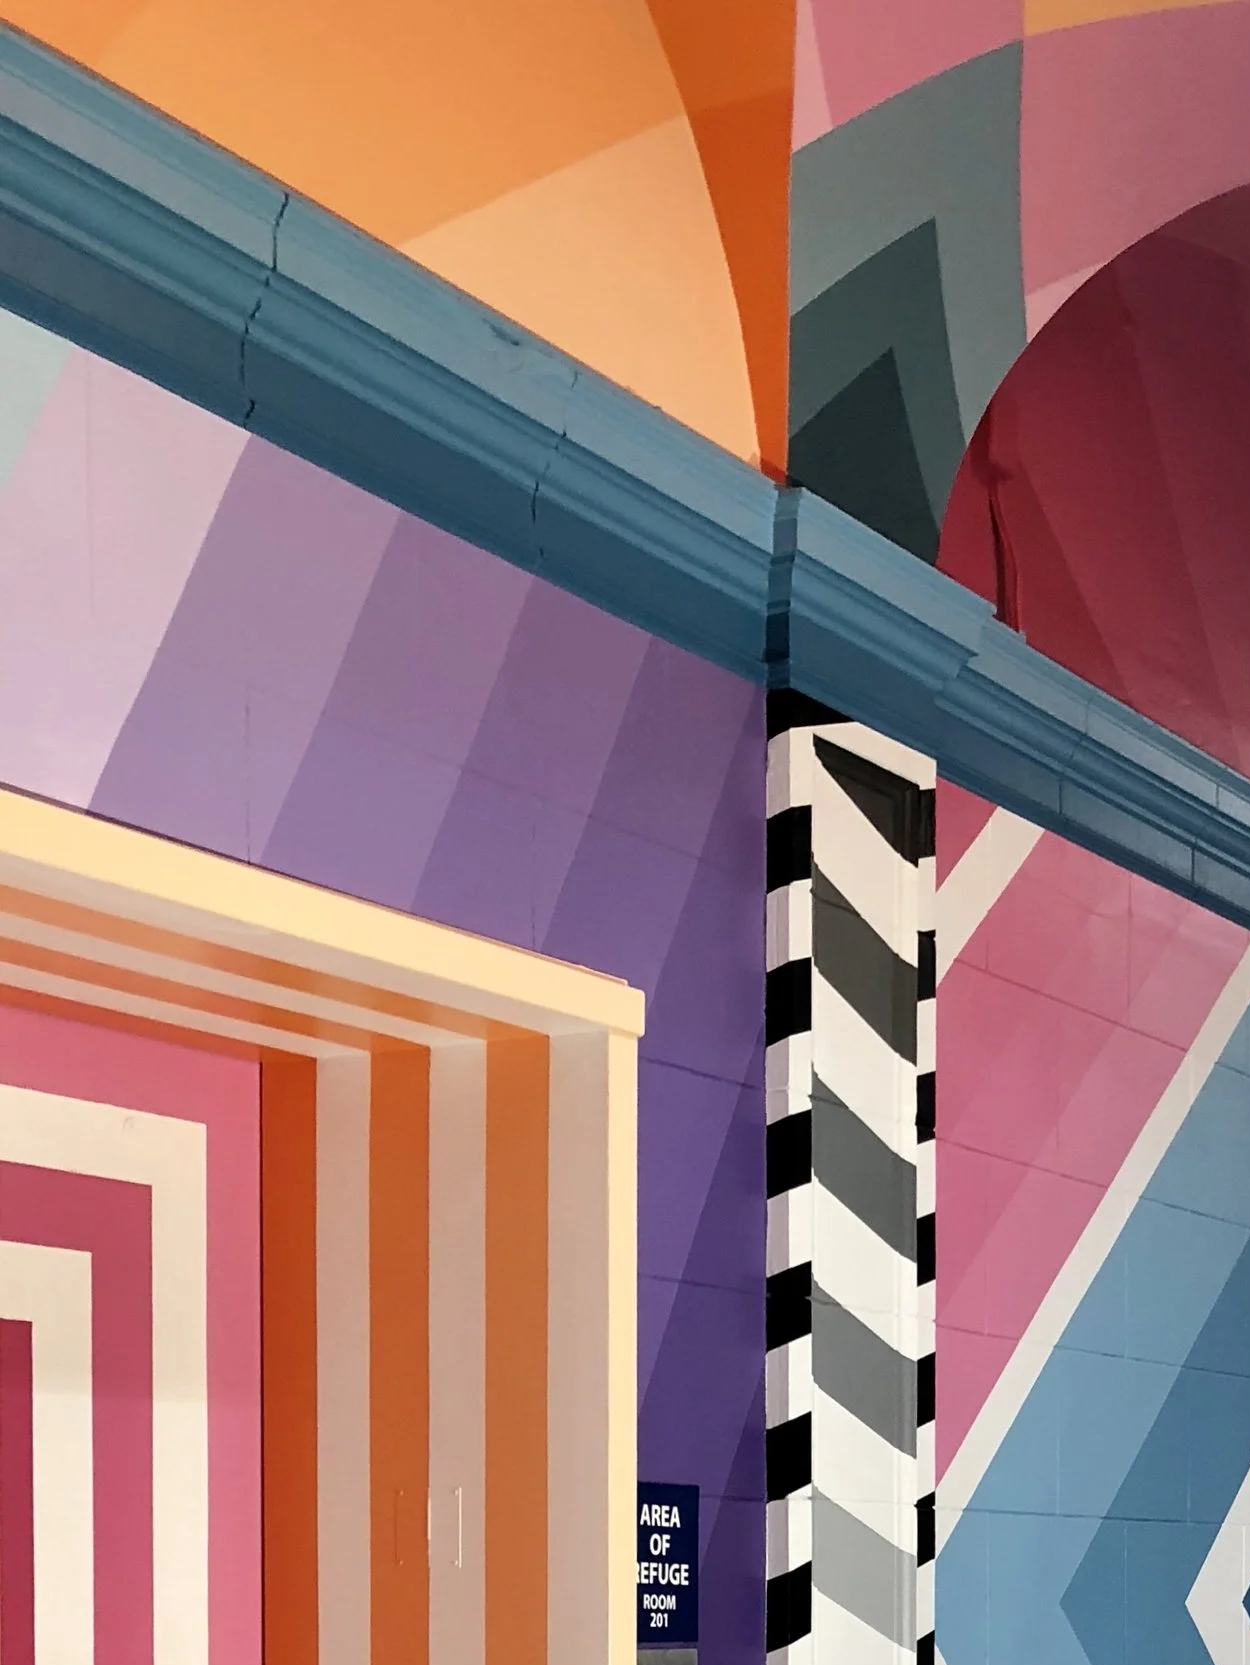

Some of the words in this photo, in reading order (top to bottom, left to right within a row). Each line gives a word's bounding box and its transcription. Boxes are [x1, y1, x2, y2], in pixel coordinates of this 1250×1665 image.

[640, 1503, 681, 1528] AREA
[650, 1533, 671, 1556] OF
[643, 1594, 676, 1610] ROOM
[650, 1612, 668, 1628] 201
